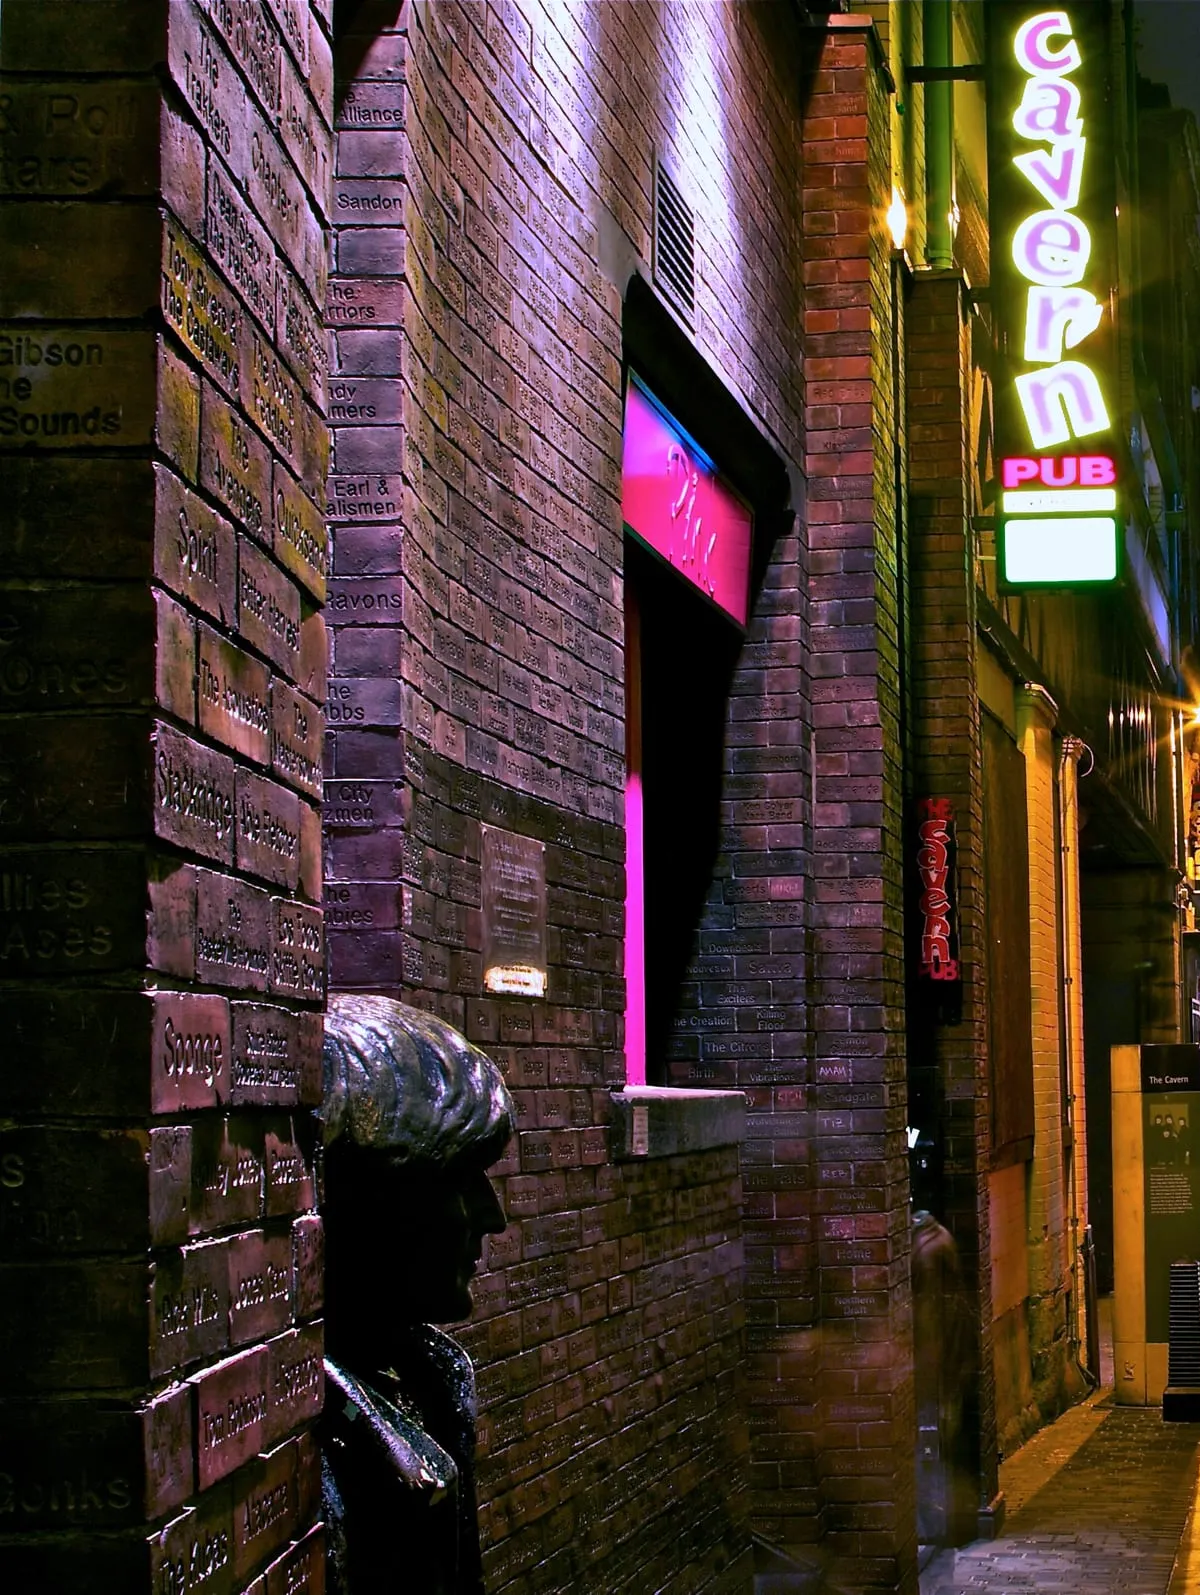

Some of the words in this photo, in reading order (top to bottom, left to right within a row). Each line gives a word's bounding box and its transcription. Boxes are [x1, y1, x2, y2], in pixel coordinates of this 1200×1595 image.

[199, 22, 218, 95] The
[184, 46, 230, 162] Trakkers
[251, 124, 289, 232] Chapter
[338, 194, 402, 210] Sandon
[208, 204, 224, 262] The
[167, 227, 193, 299] Tony
[162, 270, 182, 332] The
[253, 330, 268, 385] The
[0, 405, 121, 437] Sounds
[230, 416, 248, 474] The
[334, 480, 370, 497] Earl
[378, 480, 390, 496] &
[1002, 456, 1116, 488] PUB
[177, 502, 217, 599] Spirit
[201, 656, 218, 707] The
[294, 701, 307, 746] The
[157, 748, 232, 845] Stackridge
[339, 784, 374, 806] City
[690, 1016, 734, 1027] Creation
[163, 1017, 222, 1087] Sponge
[688, 1067, 714, 1079] Birth
[705, 1042, 728, 1053] The
[750, 1072, 796, 1082] Vibrations
[824, 1092, 878, 1104] Sandgate
[1148, 1076, 1163, 1085] The
[1164, 1075, 1189, 1085] Cavern
[203, 1402, 224, 1456] Tom
